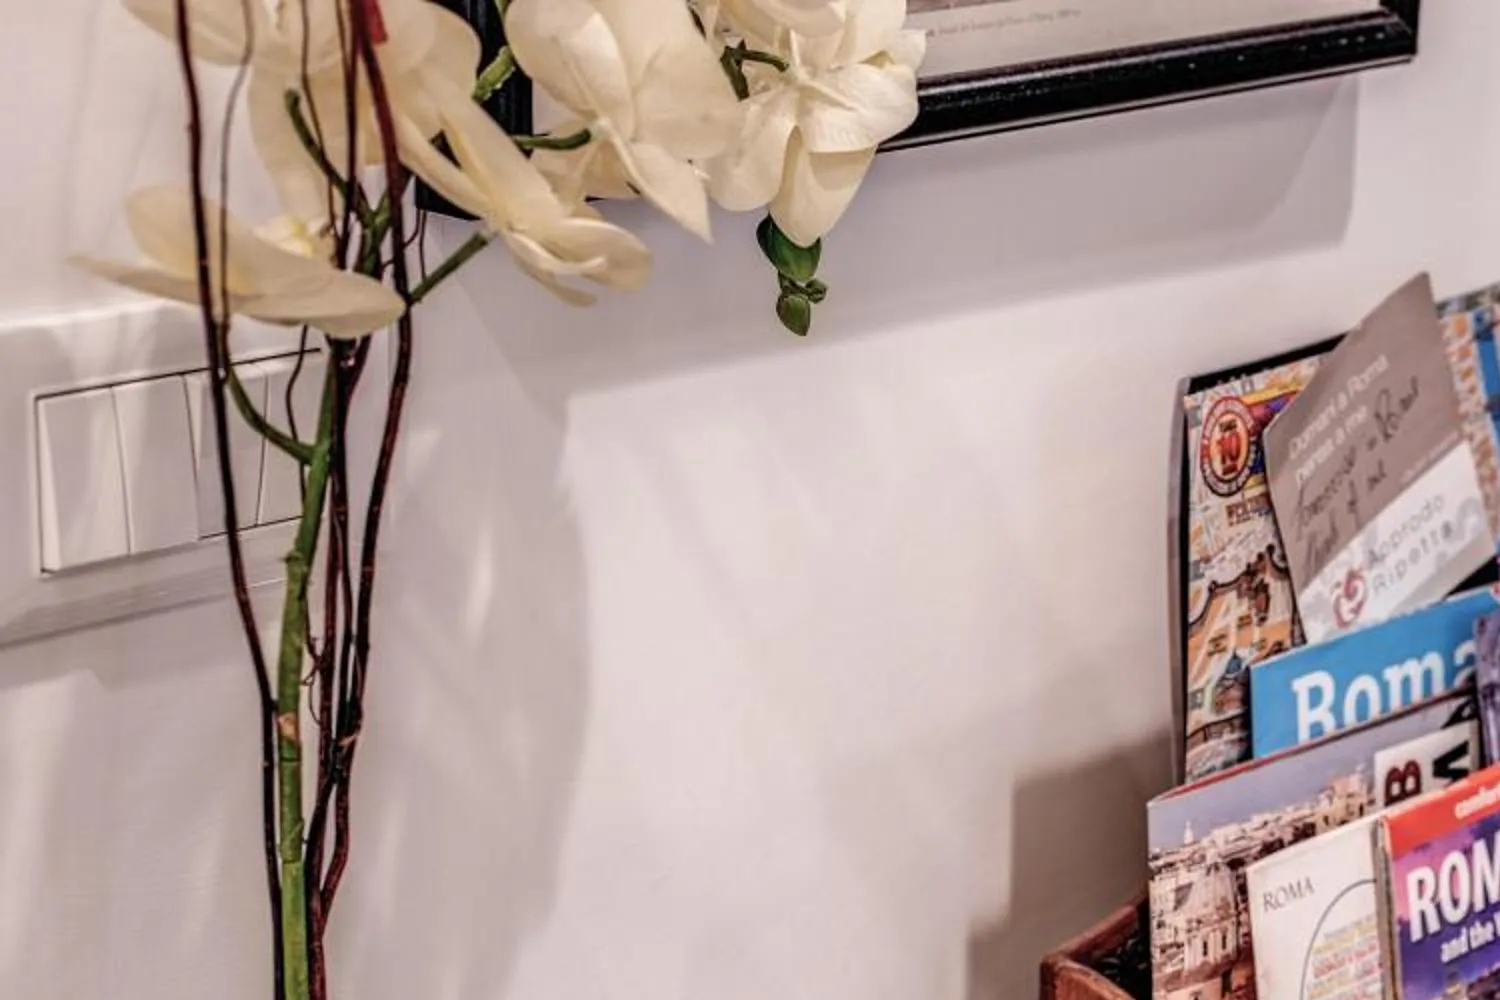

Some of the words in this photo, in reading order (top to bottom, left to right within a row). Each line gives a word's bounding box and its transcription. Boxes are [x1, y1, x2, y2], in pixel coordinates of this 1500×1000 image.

[1367, 495, 1443, 570] Approdo
[1372, 521, 1452, 596] Ripetta
[1263, 876, 1315, 912] ROMA
[1440, 928, 1469, 963] and
[1470, 917, 1495, 949] the
